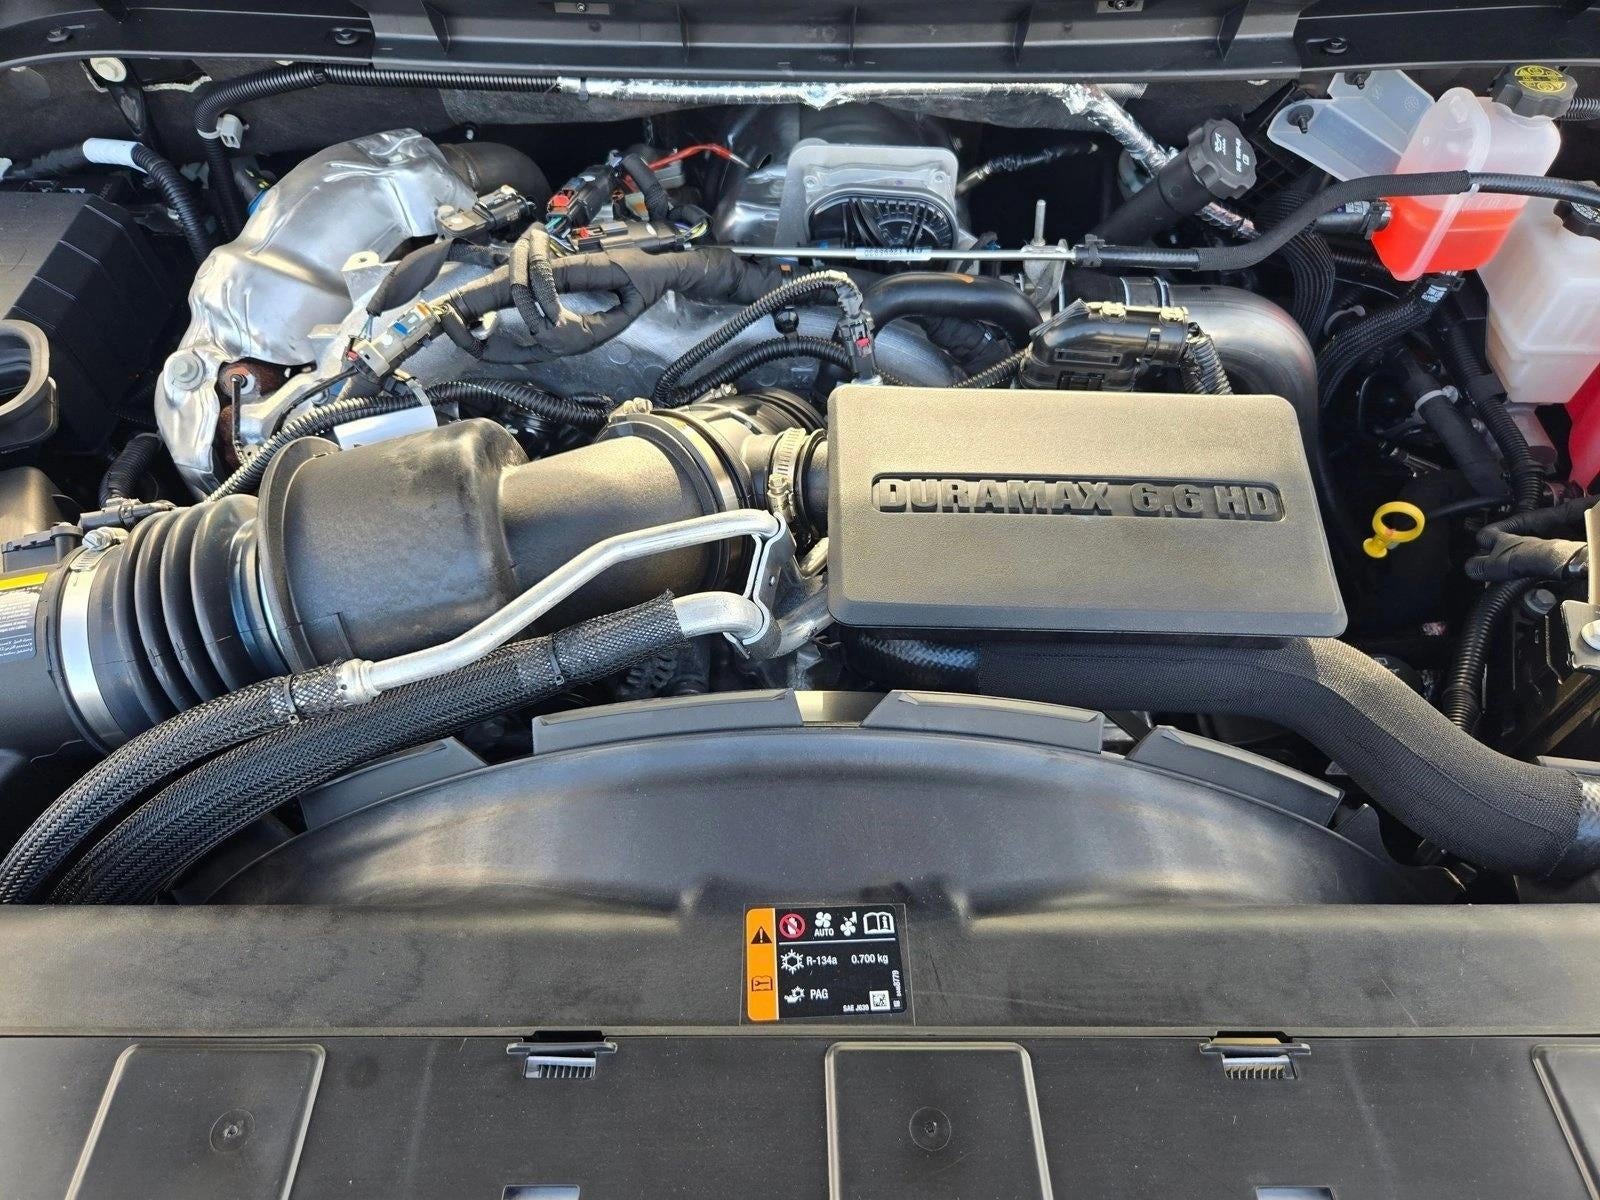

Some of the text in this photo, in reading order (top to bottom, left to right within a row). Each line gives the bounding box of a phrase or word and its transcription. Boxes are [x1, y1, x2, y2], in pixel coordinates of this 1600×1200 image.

[879, 478, 1280, 518] DURAMAX 6.6 HD
[814, 927, 834, 937] AUTO
[806, 953, 889, 966] R-134a 0.700 kg
[810, 988, 829, 1000] PAG
[843, 1004, 855, 1012] SAE
